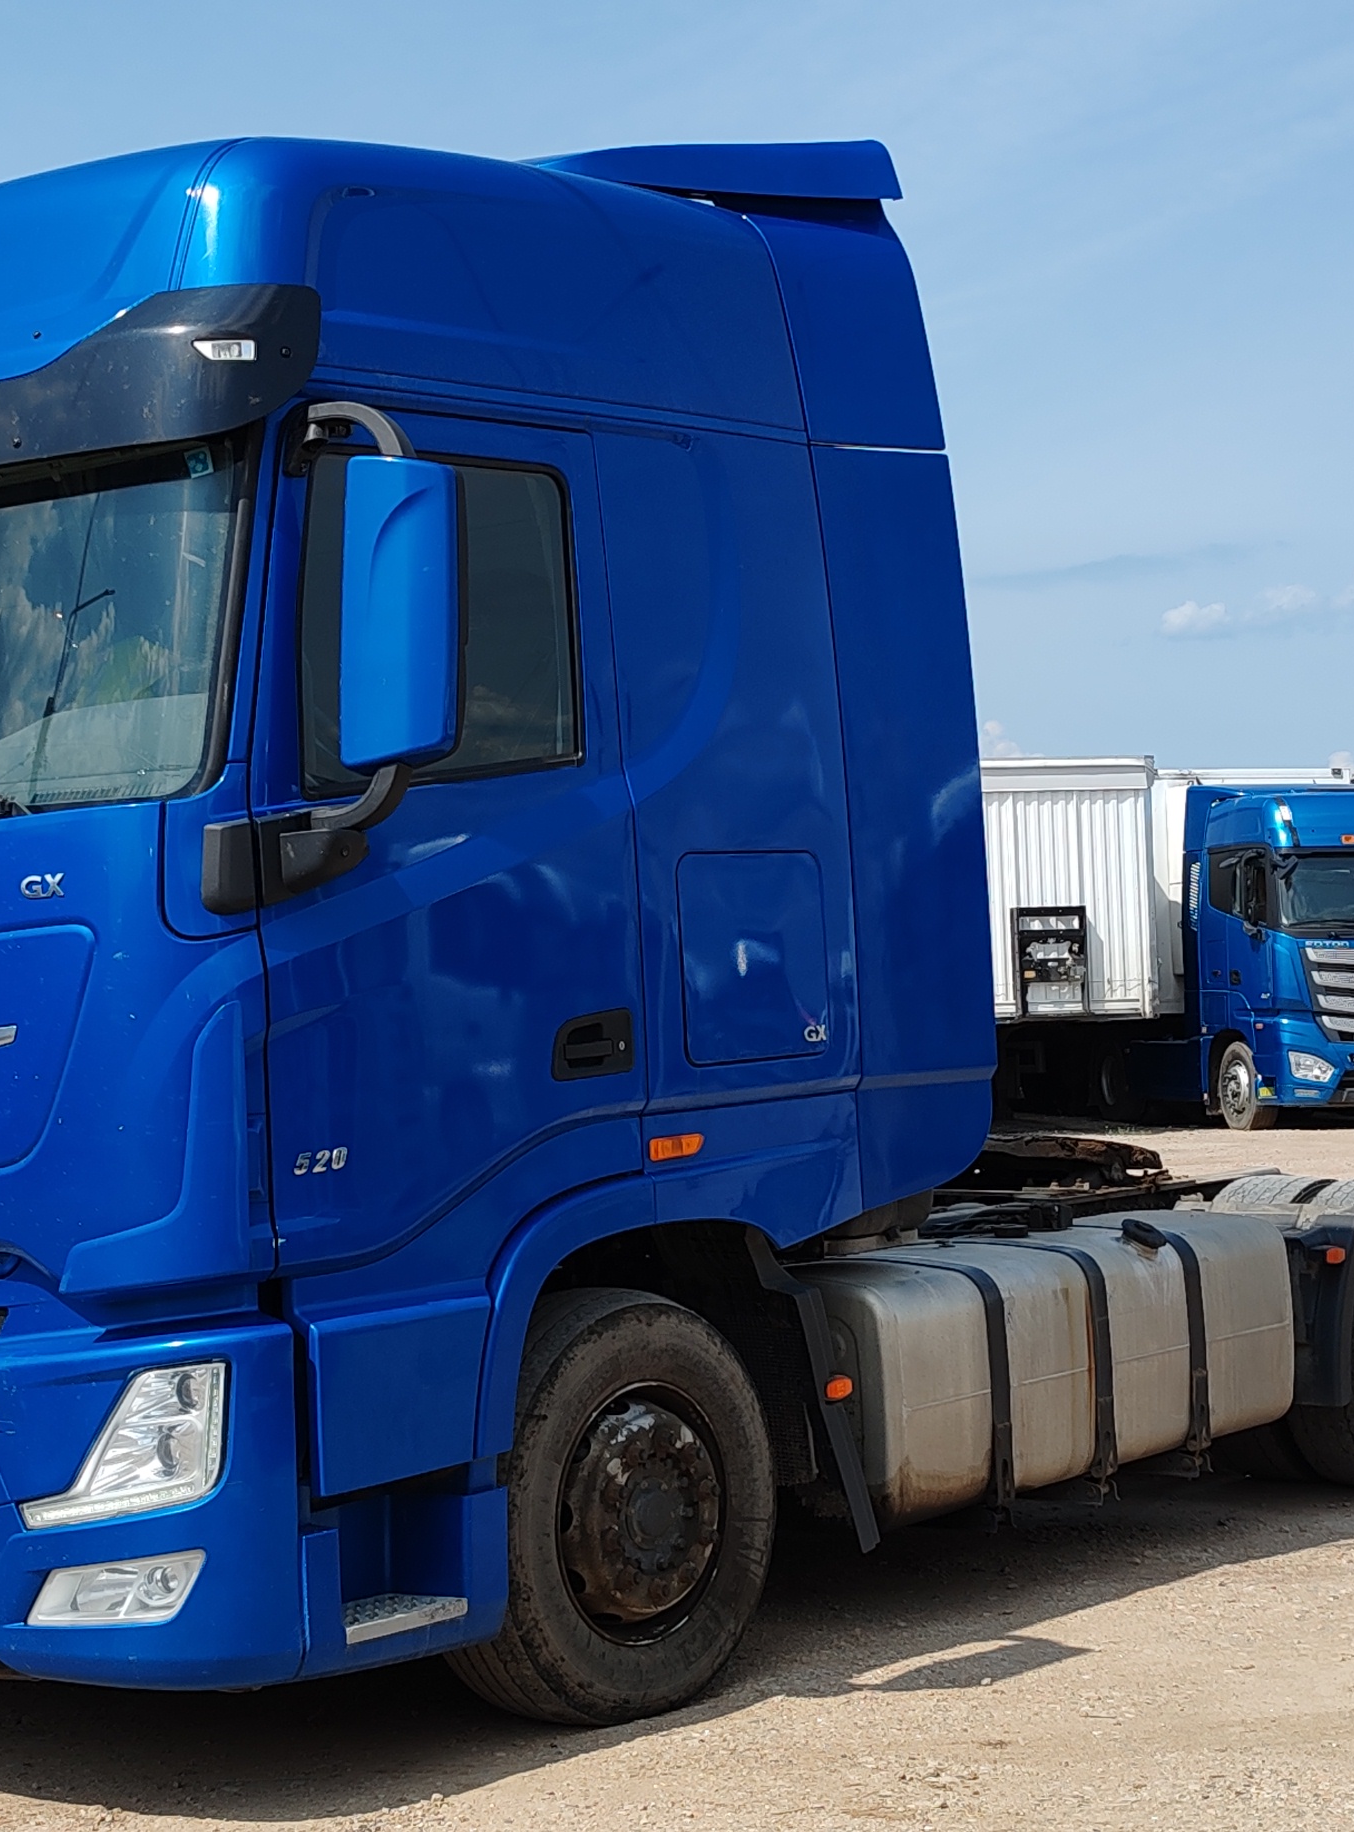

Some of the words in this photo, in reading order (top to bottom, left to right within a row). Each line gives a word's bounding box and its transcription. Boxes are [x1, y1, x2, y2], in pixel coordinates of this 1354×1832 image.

[21, 872, 65, 899] GX
[804, 1024, 827, 1042] GX
[293, 1145, 349, 1176] 520
